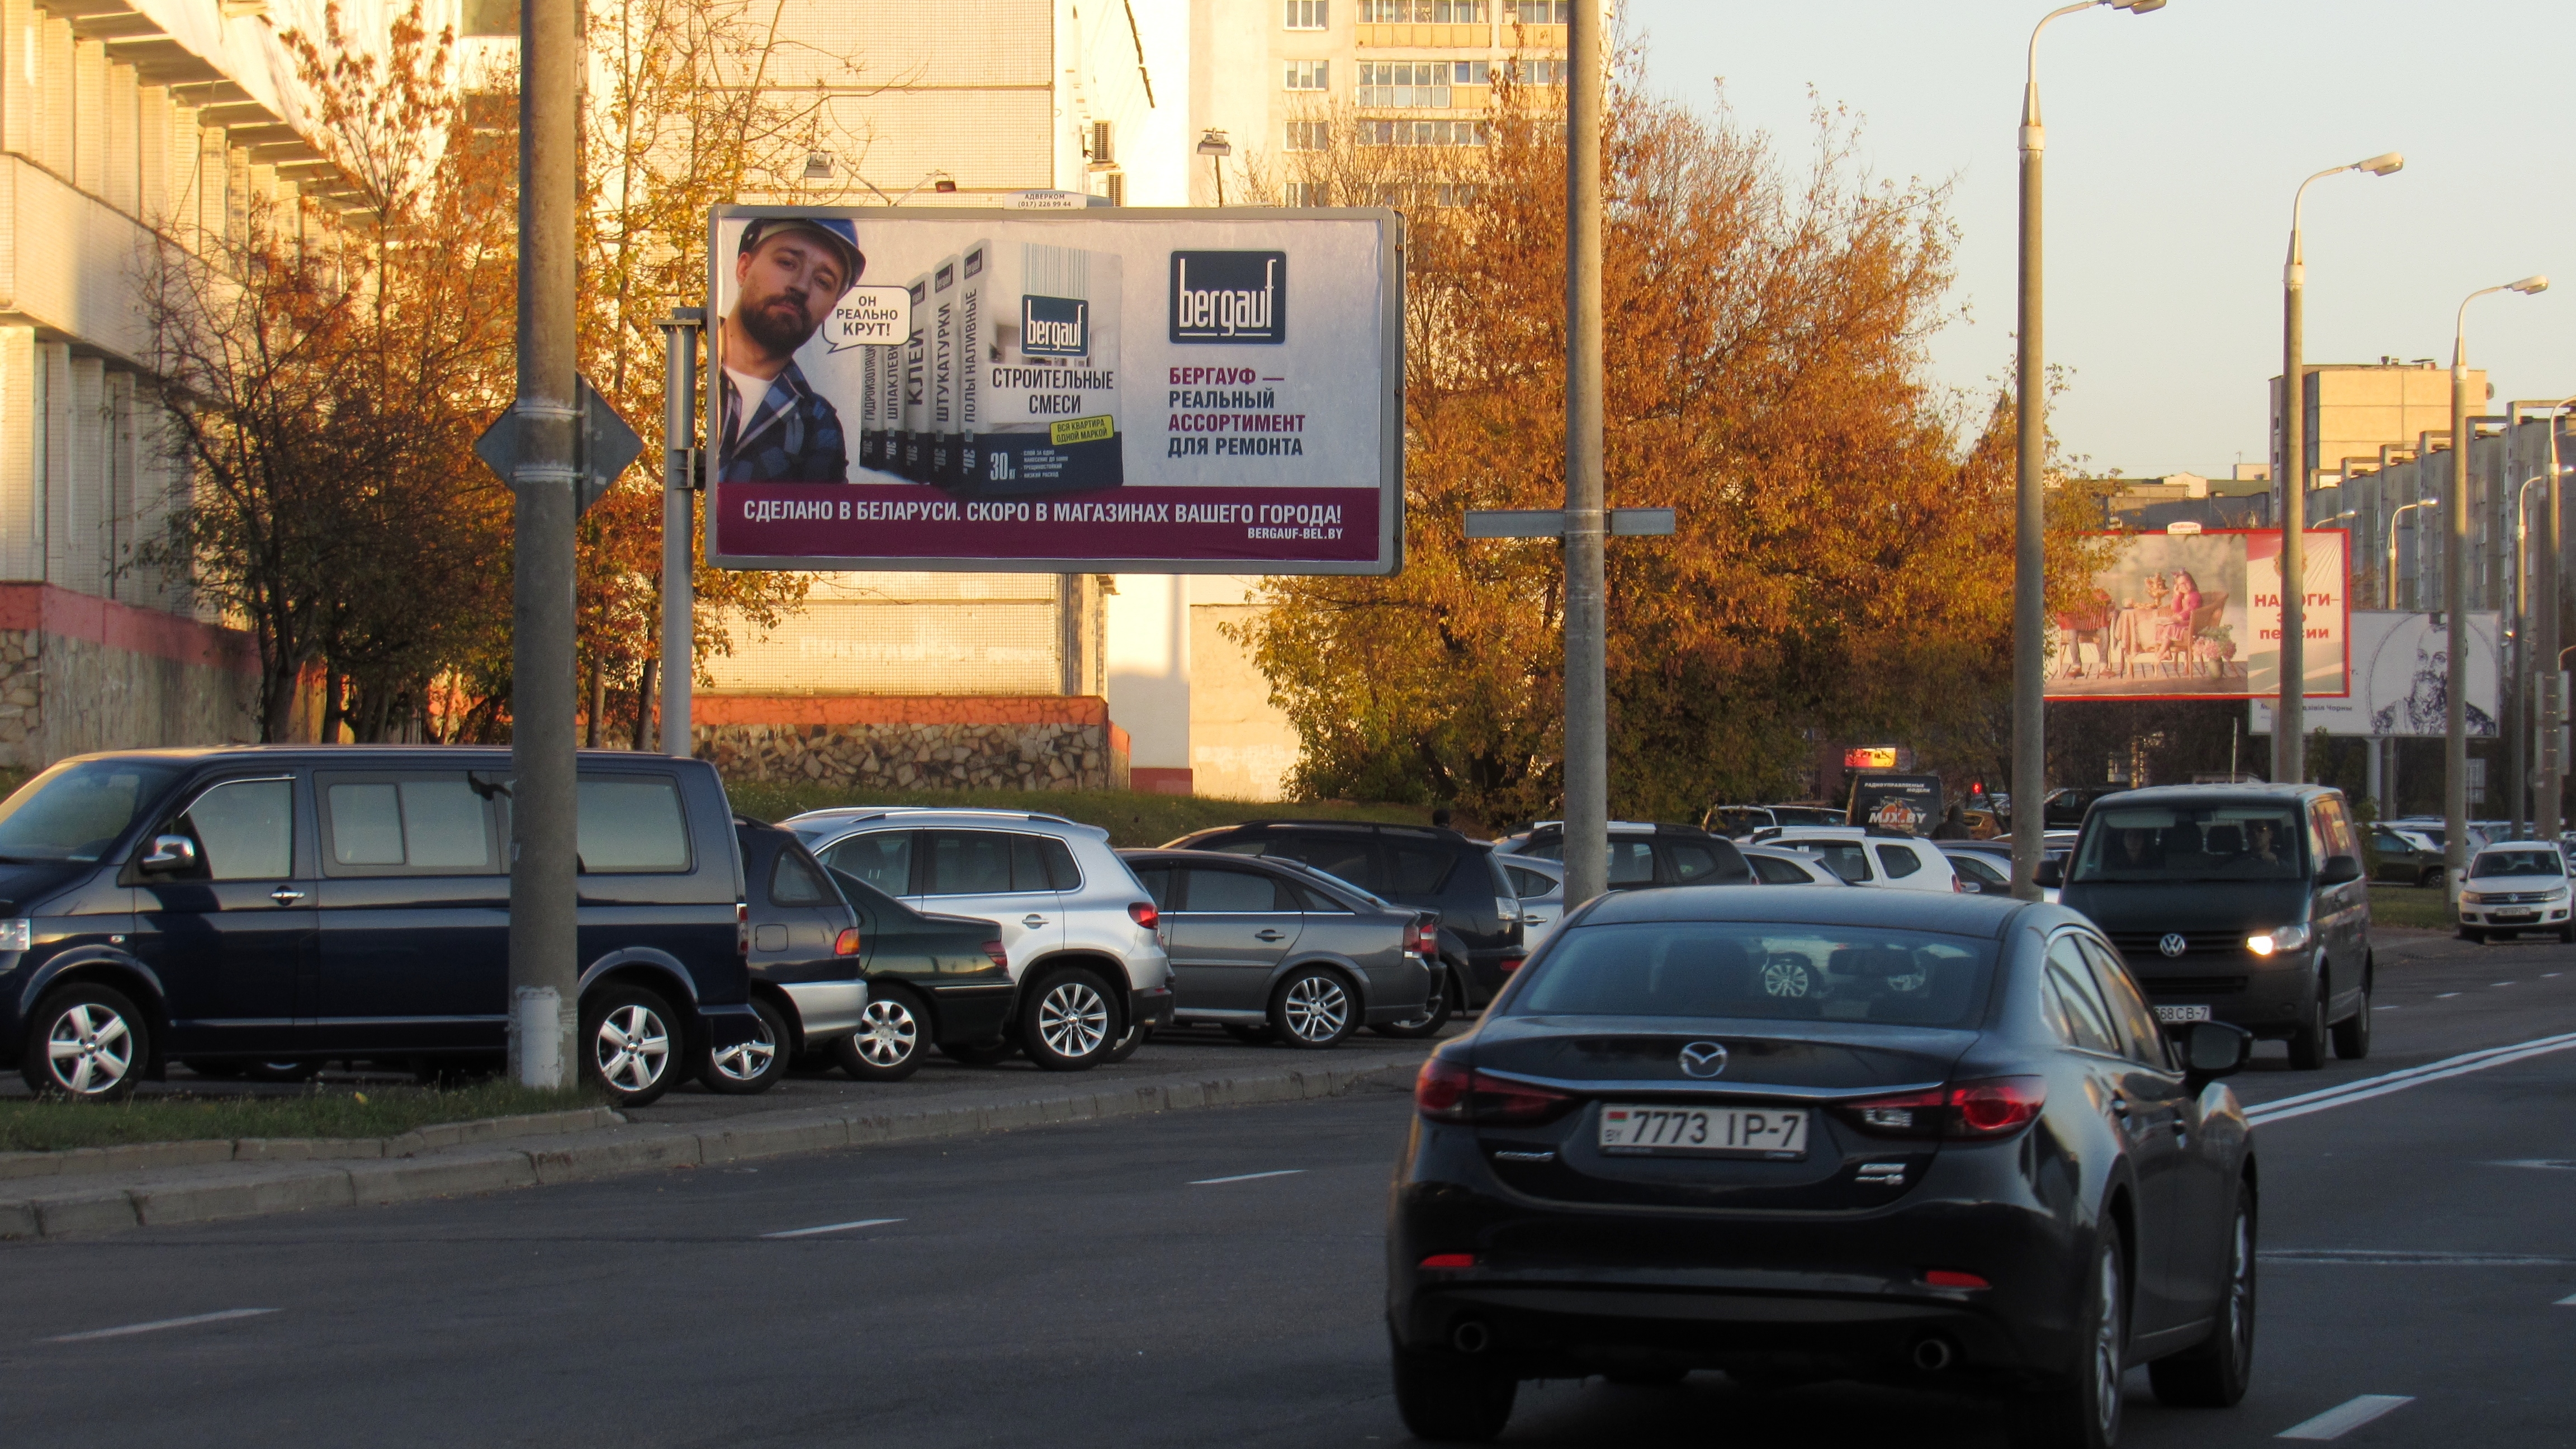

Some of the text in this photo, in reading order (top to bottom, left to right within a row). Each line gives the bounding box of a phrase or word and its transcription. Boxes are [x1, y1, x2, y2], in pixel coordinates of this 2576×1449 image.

[859, 296, 877, 307] ОН
[1179, 259, 1277, 337] bergauf
[836, 308, 898, 320] РЕАЛЬНО
[843, 322, 891, 337] КРУТ!
[1027, 299, 1084, 351] bergauf
[936, 303, 950, 422] ШТУКАТУРКИ
[964, 288, 977, 422] ПОЛЫ НАЛИВНЫЕ
[992, 368, 1114, 390] СТРОИТЕЛЬНЫЕ
[1169, 367, 1256, 385] БЕРГАУФ
[1029, 394, 1081, 414] СМЕСИ
[1169, 387, 1275, 409] РЕАЛЬНЫЙ
[1057, 419, 1105, 433] ВСЯ КВАРТИРА
[1168, 414, 1305, 432] АССОРТИМЕНТ
[1056, 428, 1108, 443] ОДНОЙ МАРКОЙ
[1167, 437, 1303, 458] ДЛЯ РЕМОНТА
[744, 500, 1342, 527] СДЕЛАНО В БЕЛАРУСИ. СКОРО В МАГАЗИНАХ ВАШЕГО ГОРОДА!
[1248, 528, 1343, 539] BERGAUF-BEL.BY
[2260, 628, 2329, 640] пеии
[1868, 812, 1927, 824] MJX.BY
[1633, 1111, 1801, 1147] 7773 IP-7
